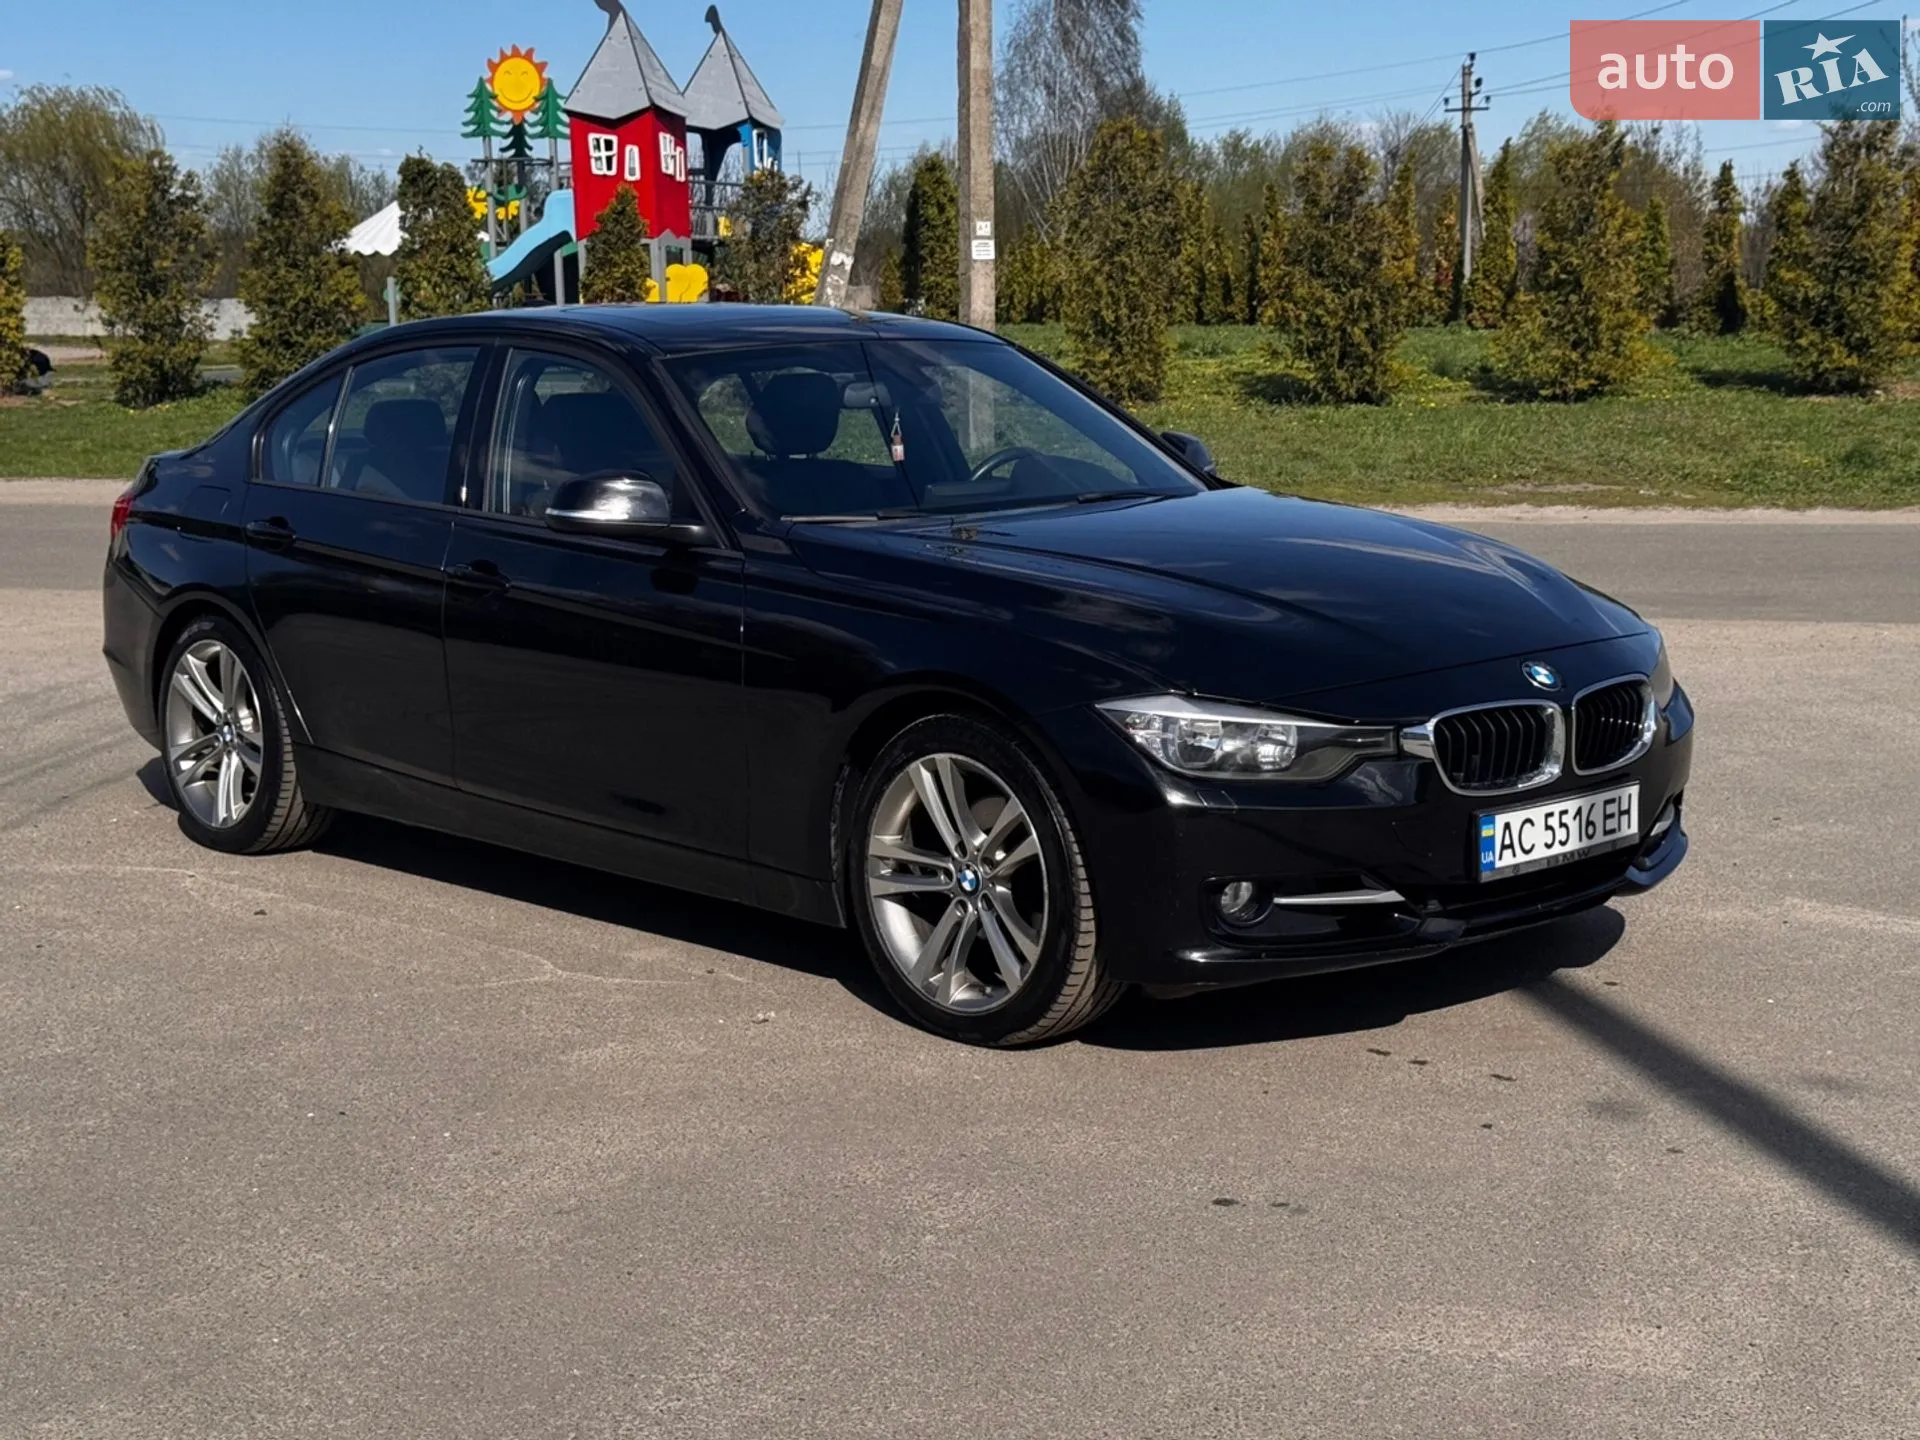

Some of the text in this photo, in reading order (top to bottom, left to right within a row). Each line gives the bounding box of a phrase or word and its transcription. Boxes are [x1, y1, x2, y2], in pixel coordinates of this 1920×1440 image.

[1498, 793, 1632, 861] AC 5516 EH
[1481, 851, 1494, 863] UA
